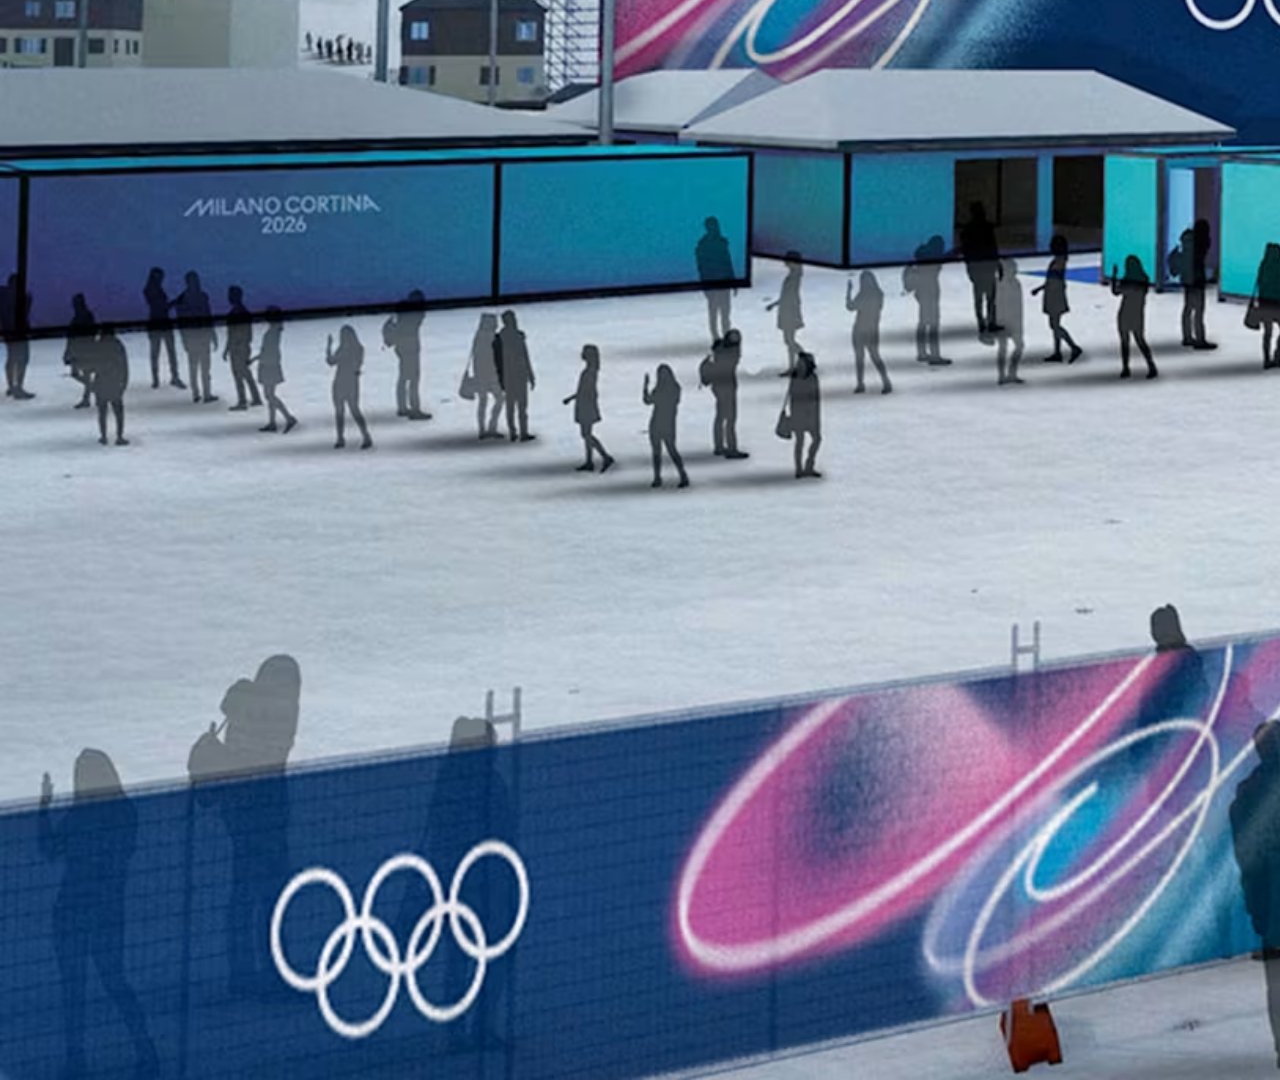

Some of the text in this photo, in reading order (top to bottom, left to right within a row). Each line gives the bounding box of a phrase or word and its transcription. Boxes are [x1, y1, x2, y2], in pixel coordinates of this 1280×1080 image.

[184, 193, 381, 217] MILANO CORTINA
[261, 216, 307, 234] 2026
